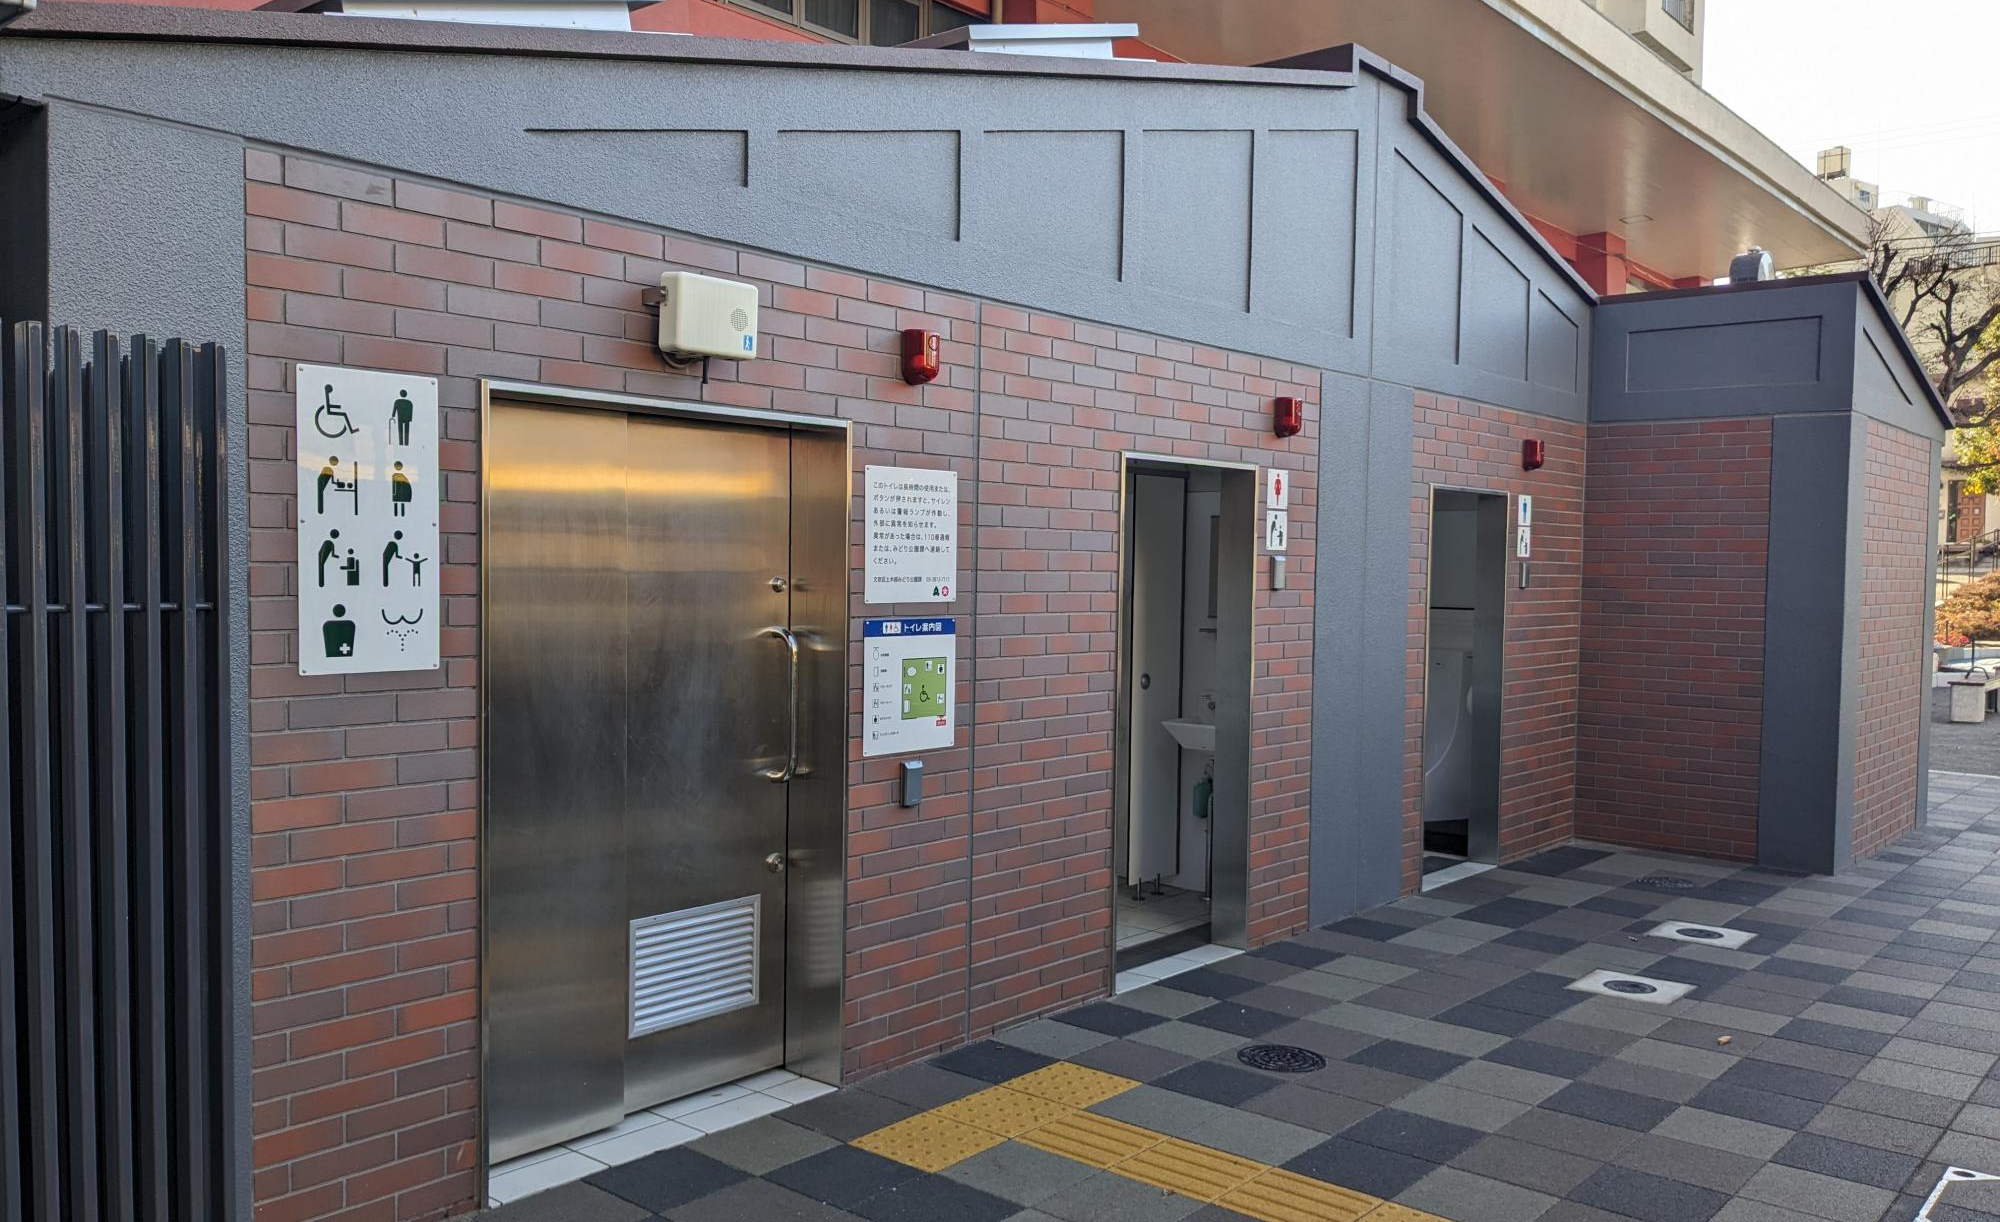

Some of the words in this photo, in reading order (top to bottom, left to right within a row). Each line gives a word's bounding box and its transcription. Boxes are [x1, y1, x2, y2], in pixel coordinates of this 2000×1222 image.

[873, 557, 897, 565] ください。
[904, 621, 942, 632] トイレ案内図
